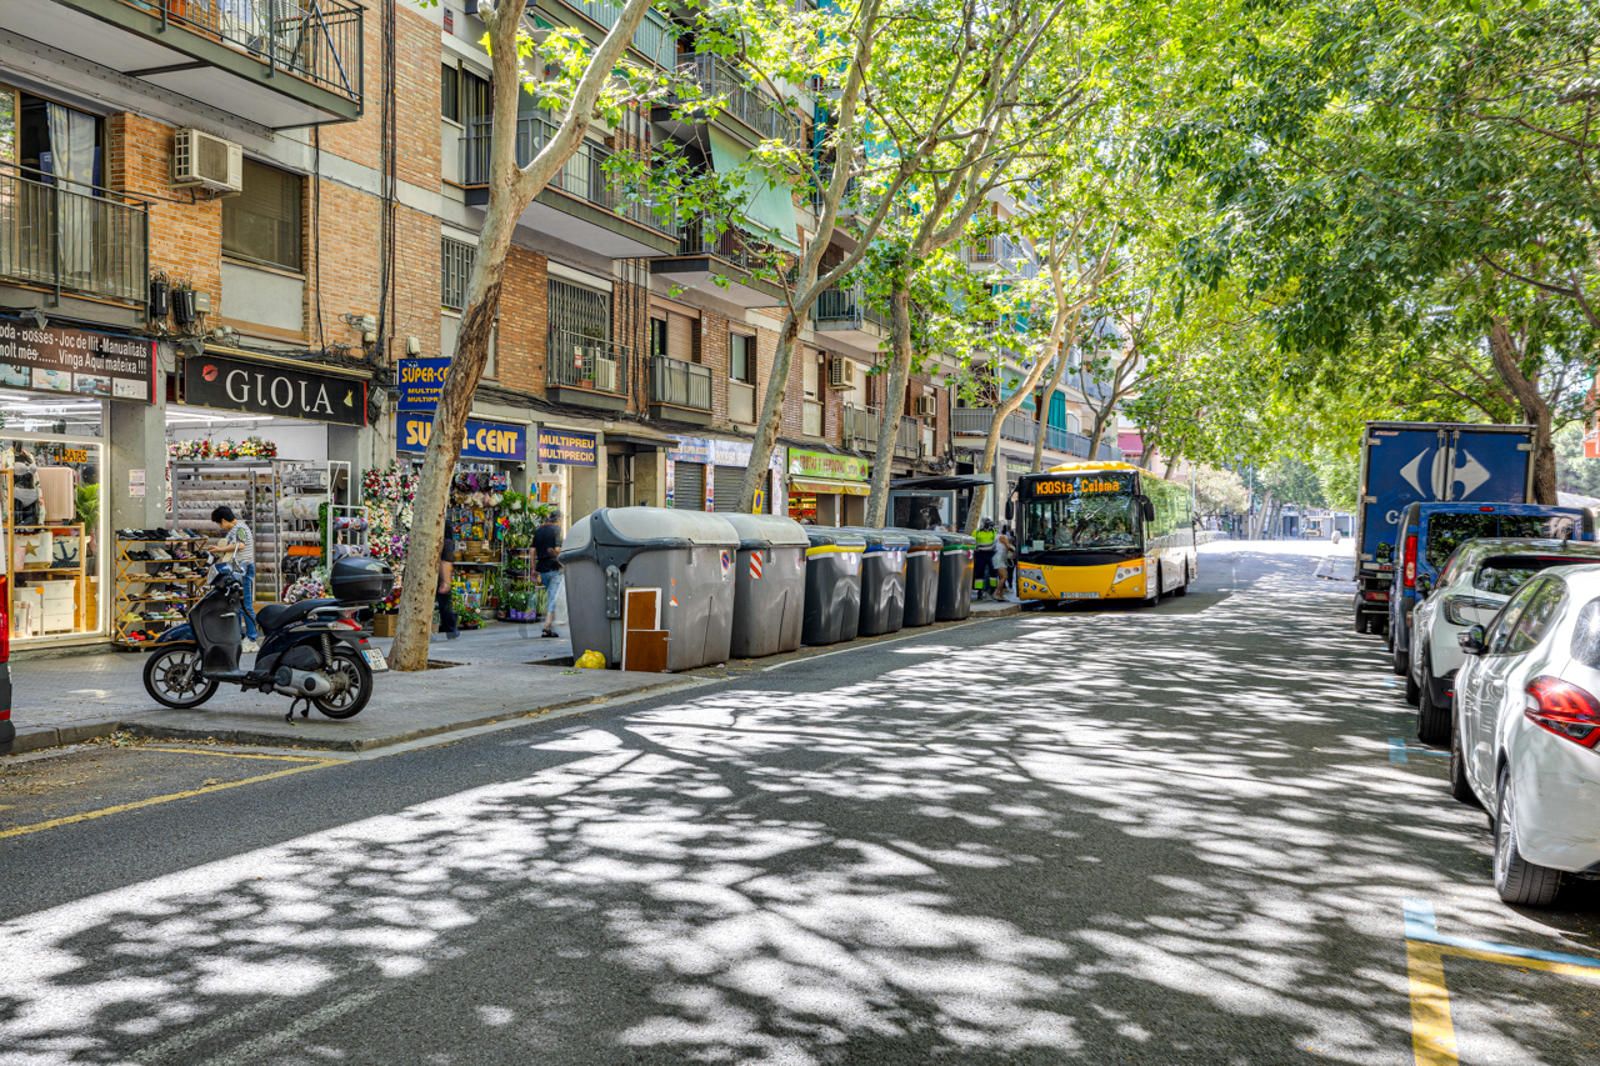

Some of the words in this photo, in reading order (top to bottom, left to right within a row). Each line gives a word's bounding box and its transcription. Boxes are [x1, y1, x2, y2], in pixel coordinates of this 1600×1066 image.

[60, 331, 75, 347] Joc
[76, 334, 87, 350] de
[88, 335, 99, 351] llit
[103, 337, 147, 358] Manualitats
[58, 349, 83, 369] Vinga
[105, 357, 137, 373] mateixa
[401, 367, 449, 382] SUPER-CE
[539, 434, 595, 449] MULTIPREU
[539, 447, 595, 462] MULTIPRECIO
